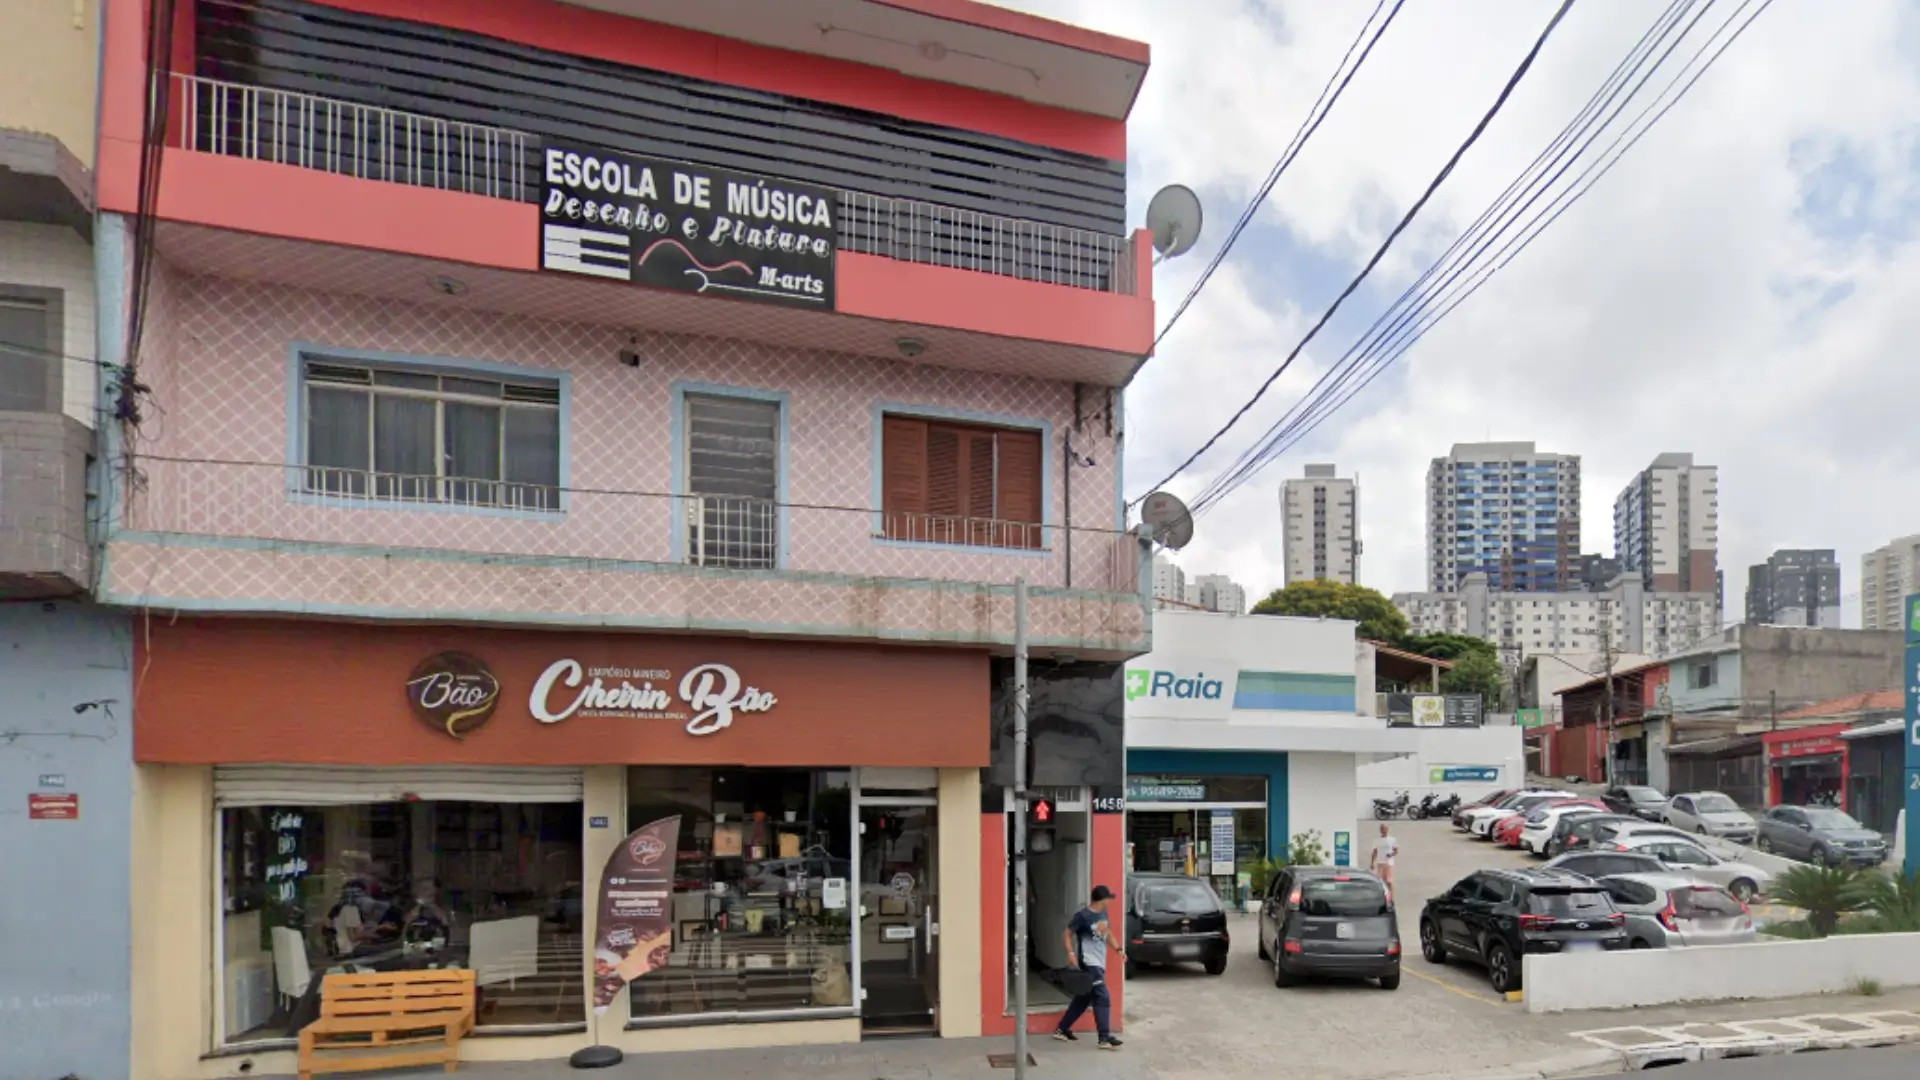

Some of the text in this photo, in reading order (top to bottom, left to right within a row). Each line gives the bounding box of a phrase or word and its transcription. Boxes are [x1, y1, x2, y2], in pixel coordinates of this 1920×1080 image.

[545, 148, 831, 228] ESCOLA DE MÚSICA
[544, 188, 669, 234] Desenho
[681, 217, 699, 239] e
[758, 265, 824, 294] M-arts
[419, 670, 488, 709] Bão
[632, 667, 672, 680] MINEIRO
[1150, 670, 1223, 700] Raia
[529, 657, 778, 736] Cheirin Bão
[1092, 797, 1124, 811] 1458
